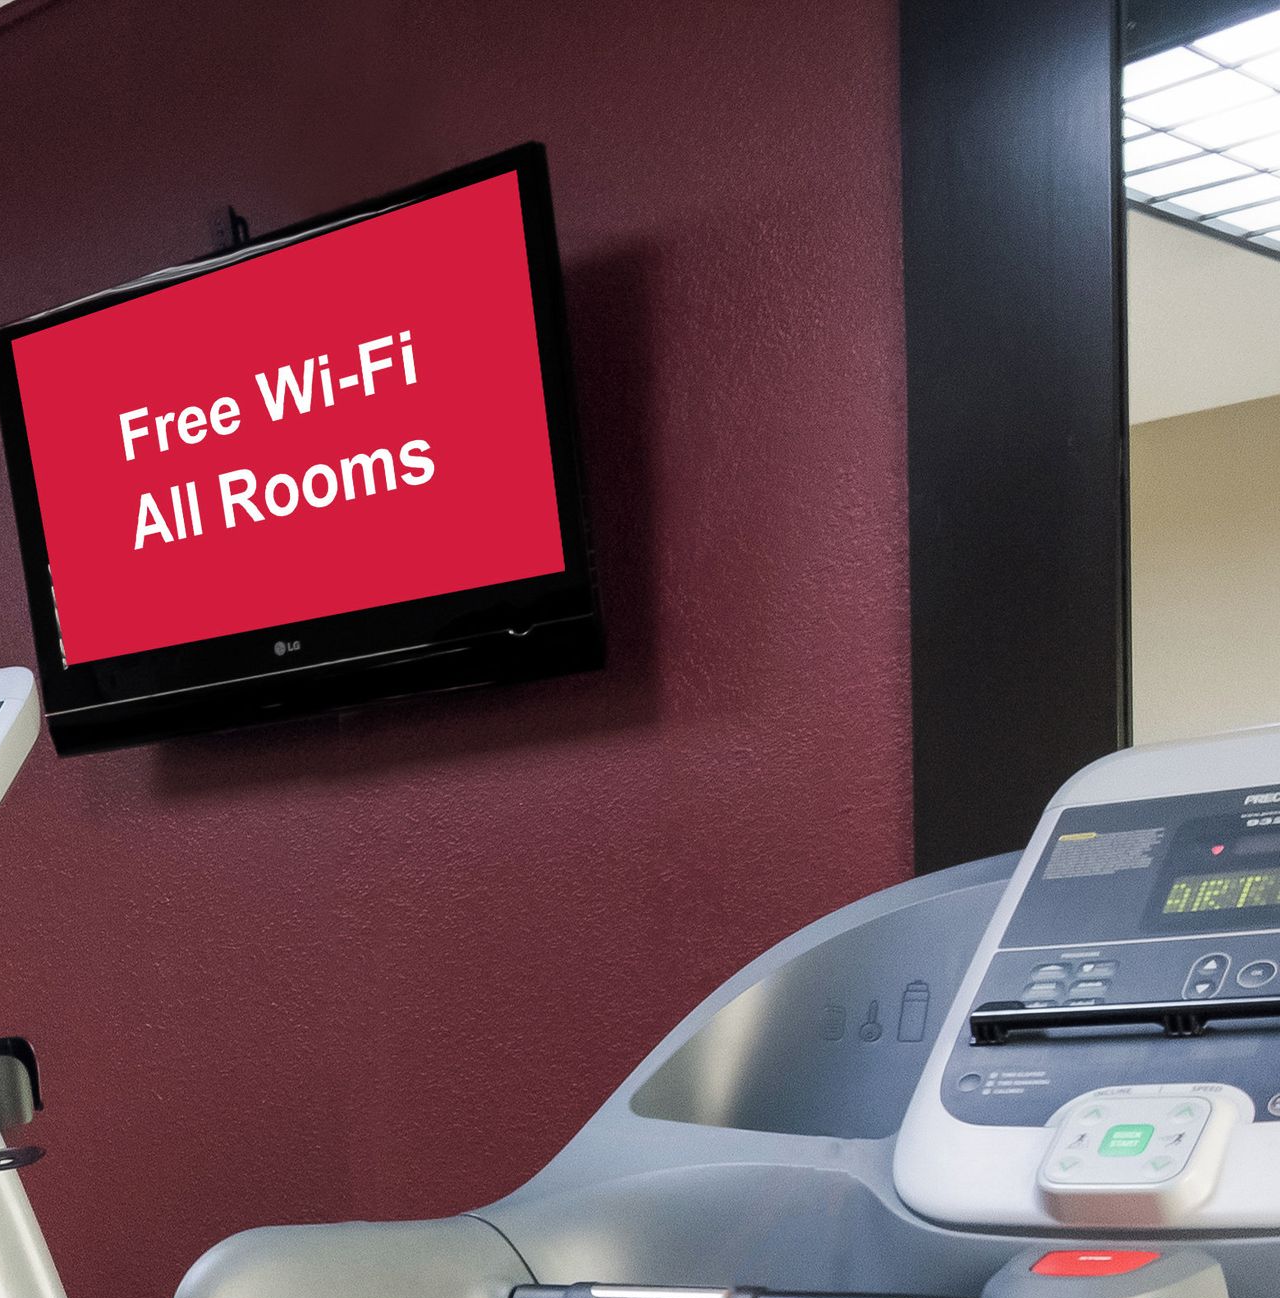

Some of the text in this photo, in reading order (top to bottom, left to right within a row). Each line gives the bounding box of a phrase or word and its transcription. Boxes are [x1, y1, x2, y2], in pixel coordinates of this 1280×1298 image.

[120, 330, 417, 462] Free Wi-Fi
[135, 440, 435, 551] All Rooms
[287, 640, 301, 652] LG
[1191, 1085, 1223, 1093] SPEED
